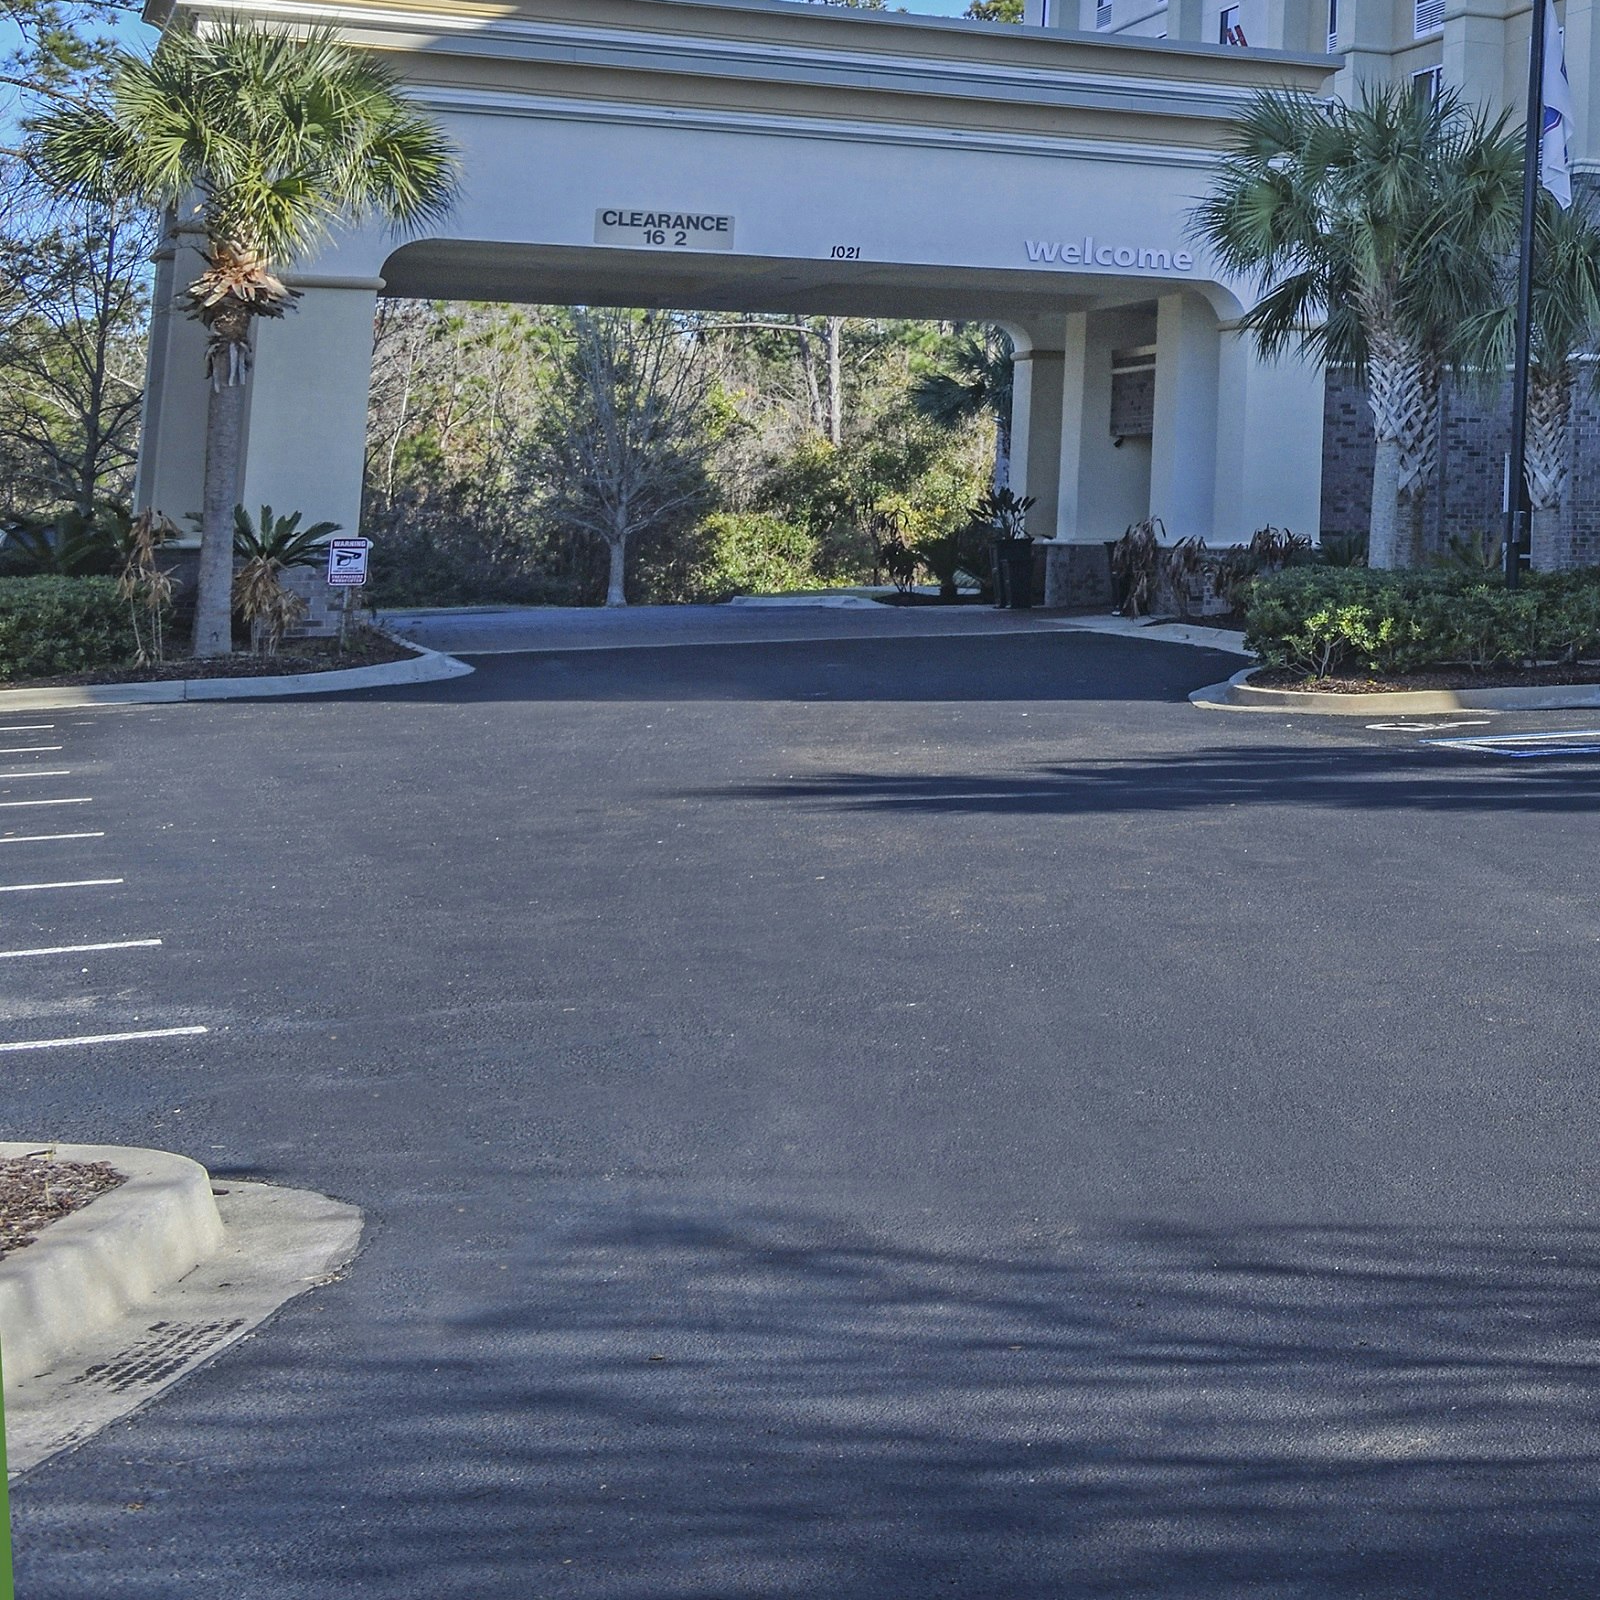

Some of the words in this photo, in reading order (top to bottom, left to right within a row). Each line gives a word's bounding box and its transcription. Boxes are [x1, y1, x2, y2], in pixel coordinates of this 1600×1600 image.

[602, 210, 729, 232] CLEARANCE
[643, 230, 665, 245] 16
[674, 231, 687, 246] 2
[830, 245, 861, 260] 1021
[1025, 236, 1193, 271] welcome
